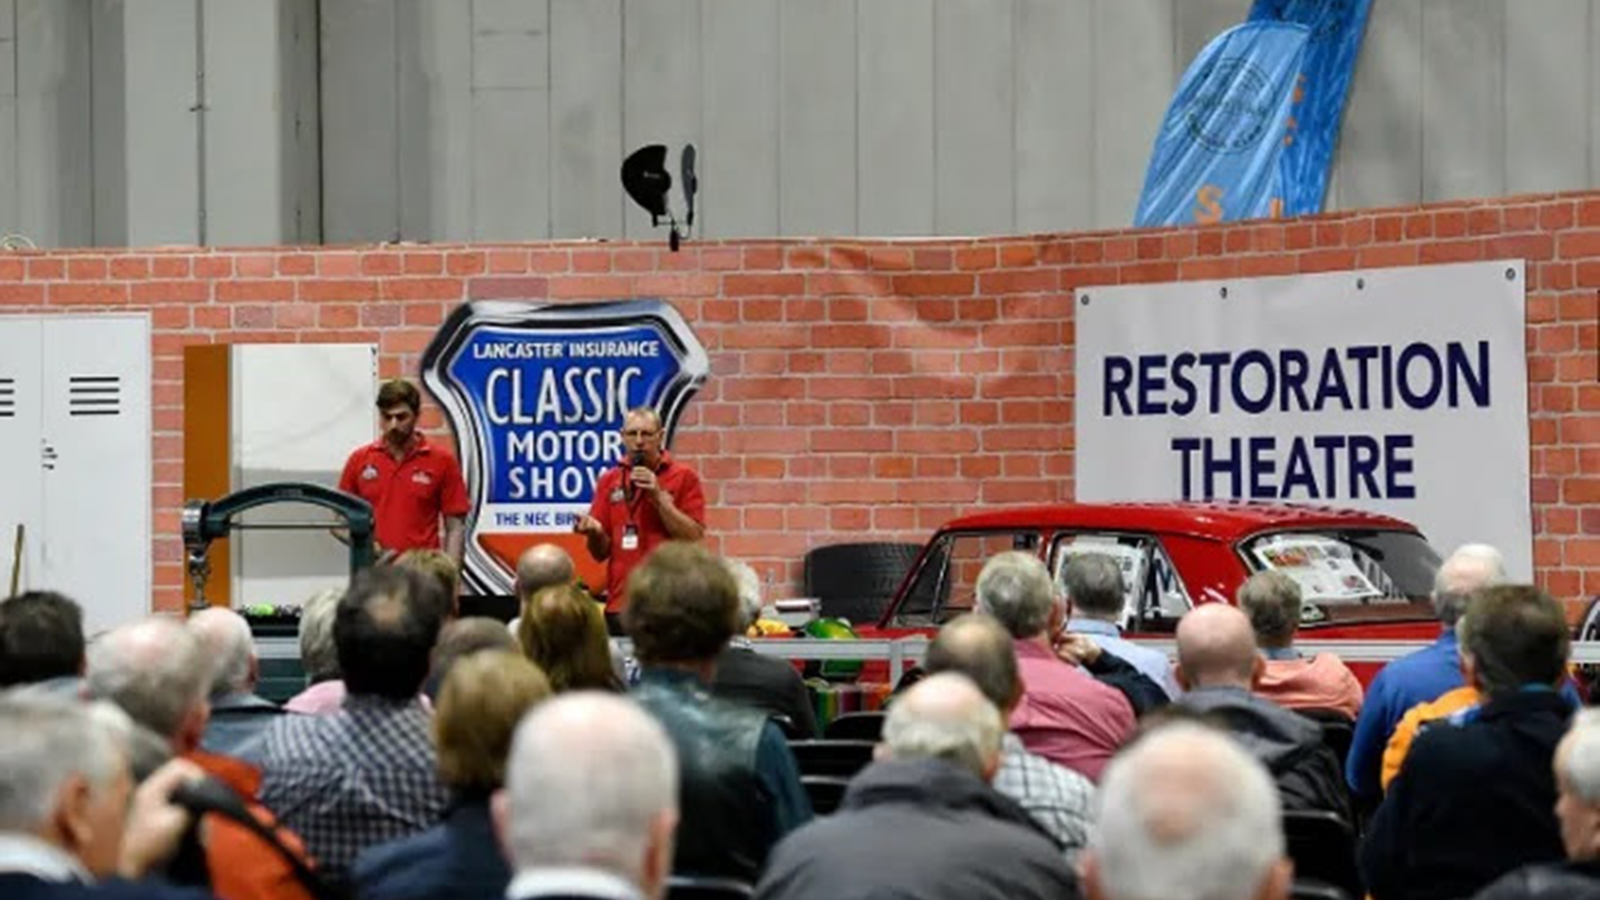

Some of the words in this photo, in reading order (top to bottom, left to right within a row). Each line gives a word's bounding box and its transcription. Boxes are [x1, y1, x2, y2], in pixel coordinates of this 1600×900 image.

[473, 342, 564, 359] LANCASTER
[569, 340, 660, 357] INSURANCE
[486, 366, 642, 425] CLASSIC
[1102, 340, 1491, 417] RESTORATION
[507, 430, 623, 463] MOTOR
[1171, 434, 1417, 502] THEATRE
[495, 512, 520, 526] THE
[525, 512, 550, 526] NEC
[555, 511, 577, 526] BIR
